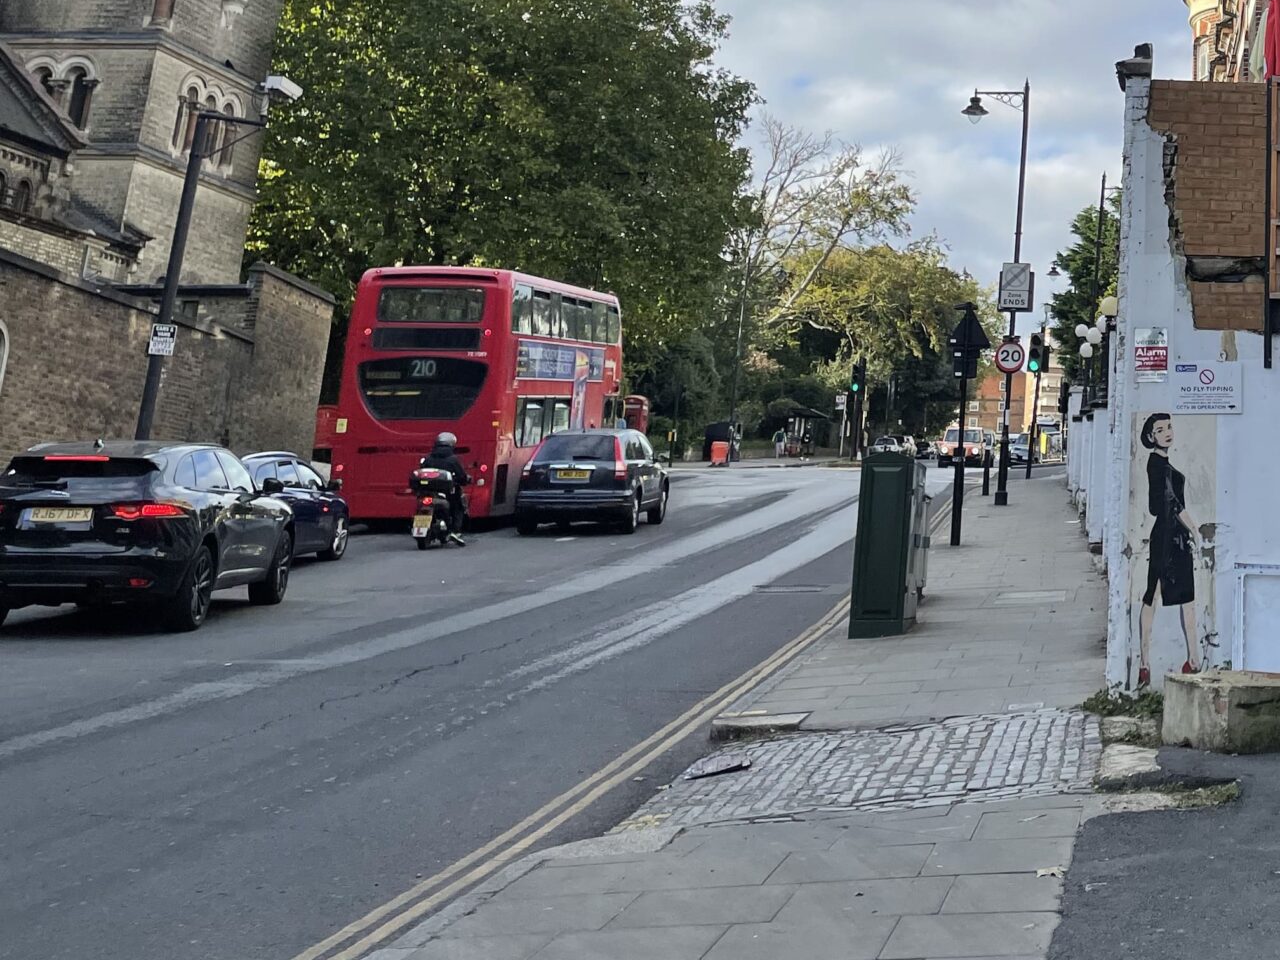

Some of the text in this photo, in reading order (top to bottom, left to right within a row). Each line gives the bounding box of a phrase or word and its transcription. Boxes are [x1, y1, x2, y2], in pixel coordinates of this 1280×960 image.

[1003, 298, 1026, 306] ENDS
[1000, 350, 1021, 362] 20
[1136, 348, 1166, 356] Alarm
[411, 359, 437, 377] 210
[32, 508, 89, 519] RJ67 DFX
